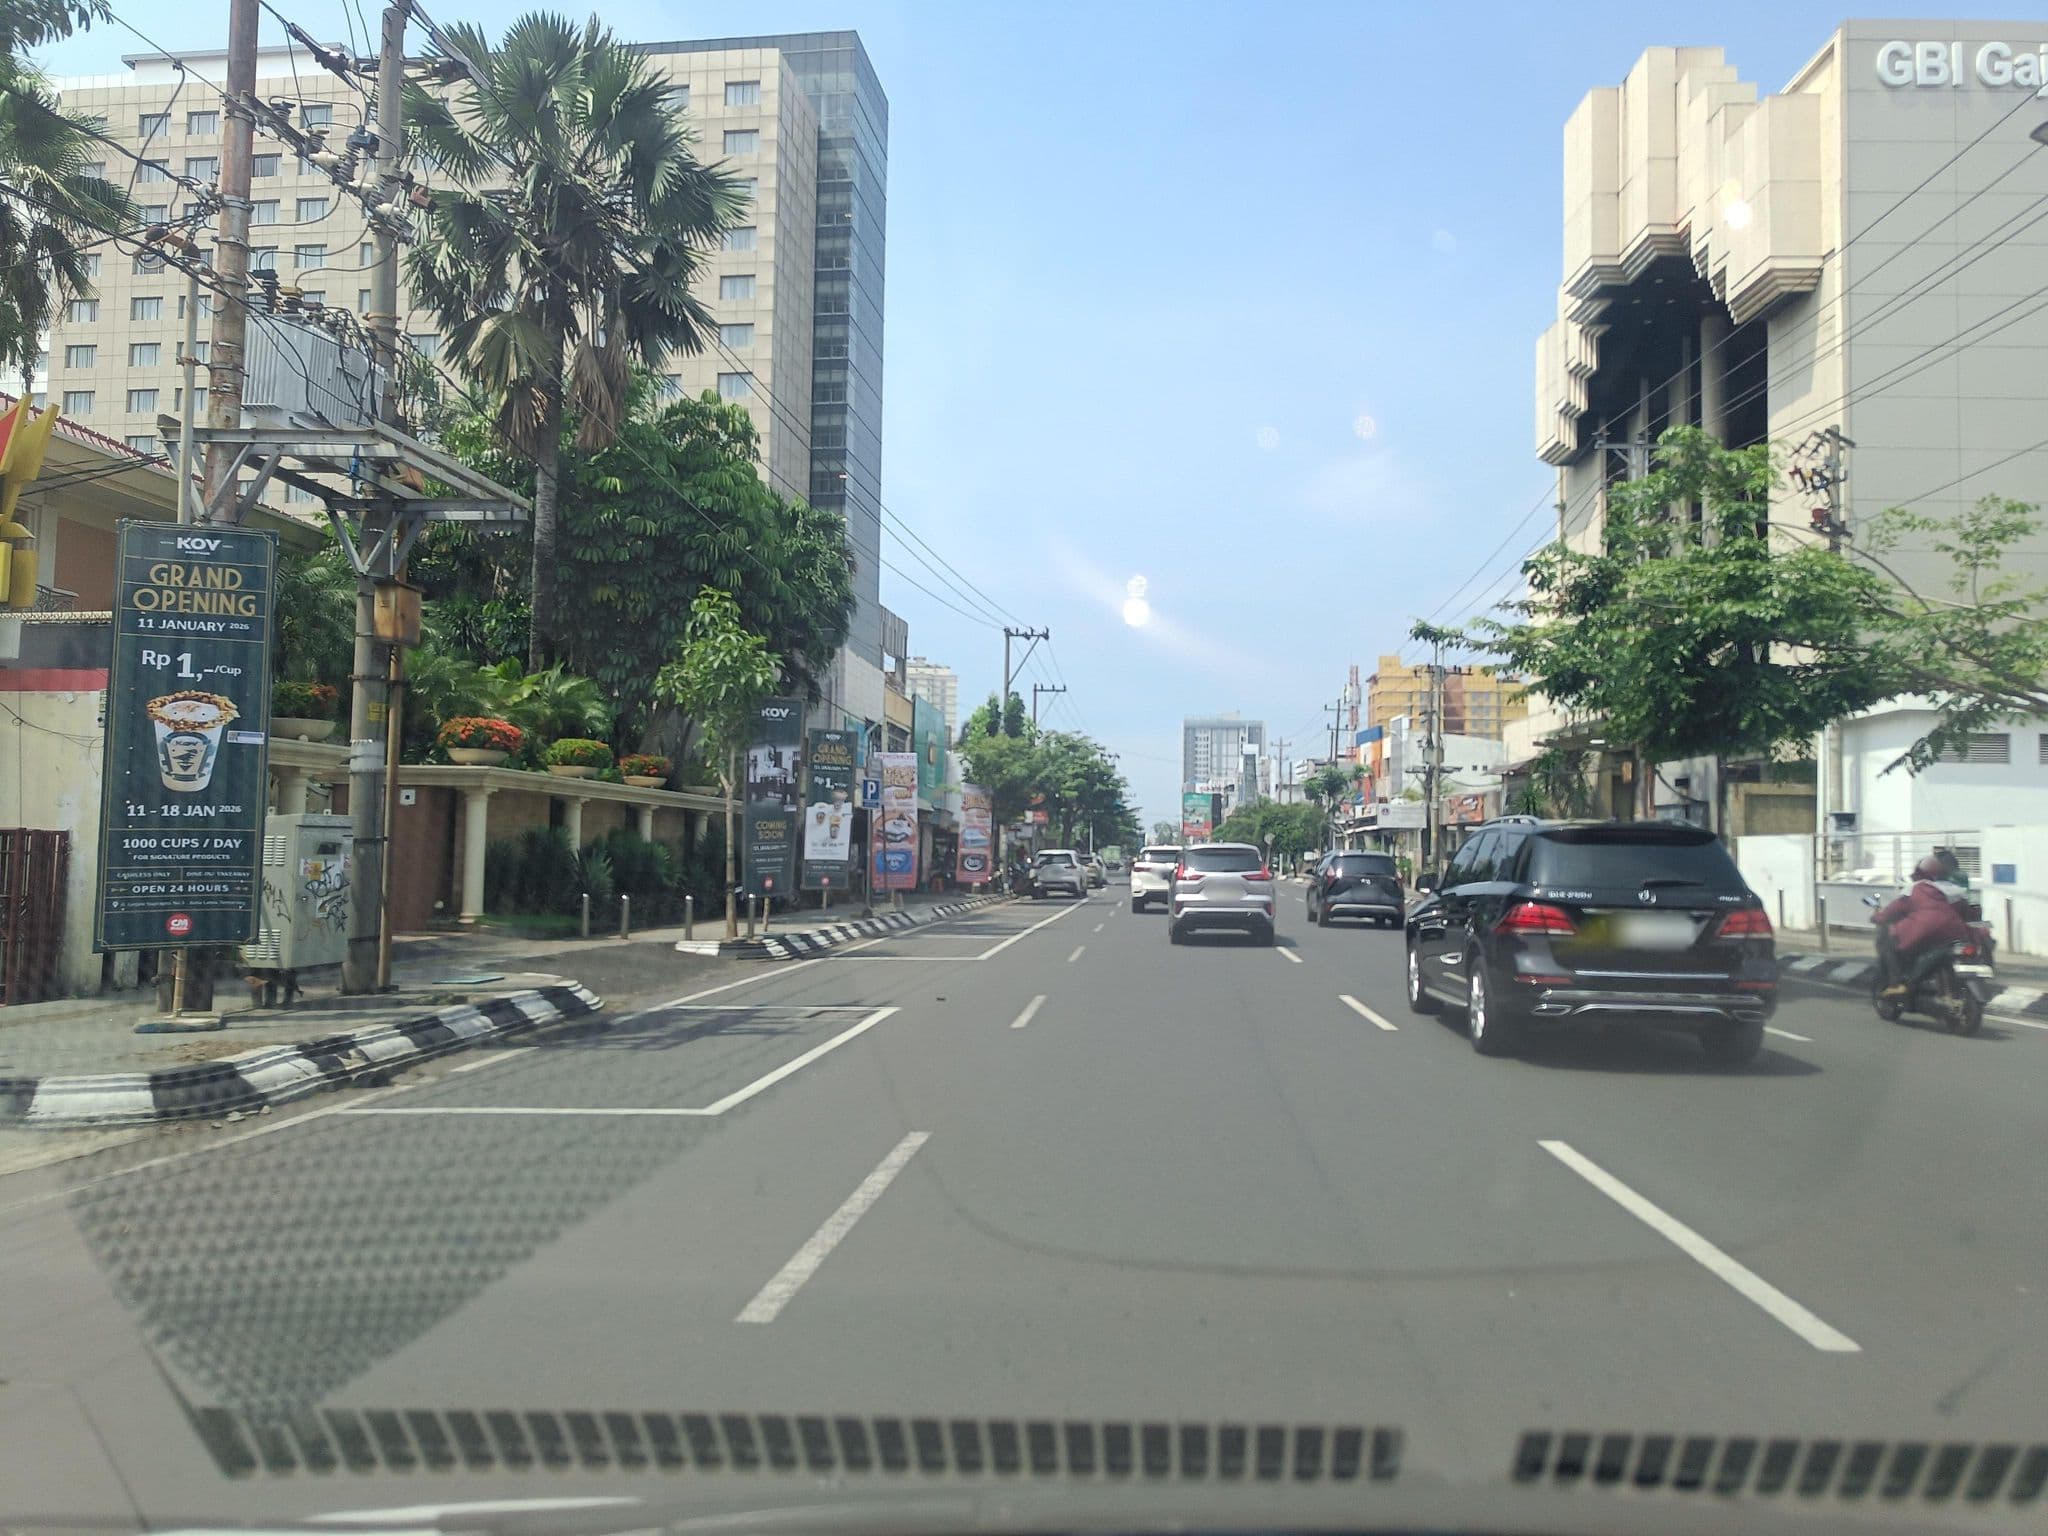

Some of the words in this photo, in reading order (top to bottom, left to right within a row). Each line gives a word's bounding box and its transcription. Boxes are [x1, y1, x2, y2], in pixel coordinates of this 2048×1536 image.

[1876, 40, 1963, 87] GBI
[177, 537, 222, 551] KOV
[149, 563, 243, 591] GRAND
[133, 588, 256, 617] OPENING
[138, 618, 155, 628] 11
[158, 619, 226, 632] JANUARY
[229, 622, 250, 630] 2026
[142, 650, 171, 670] Rp
[761, 707, 790, 718] KOV
[866, 781, 877, 800] P
[127, 805, 146, 817] 11
[161, 804, 180, 817] 18
[183, 805, 216, 817] JAN
[219, 804, 242, 813] 2026
[123, 838, 157, 849] 1000
[161, 838, 200, 849] CUPS
[203, 838, 209, 849] /
[214, 838, 242, 849] DAY
[132, 885, 166, 894] OPEN
[169, 884, 184, 893] 24
[188, 884, 230, 893] HOURS
